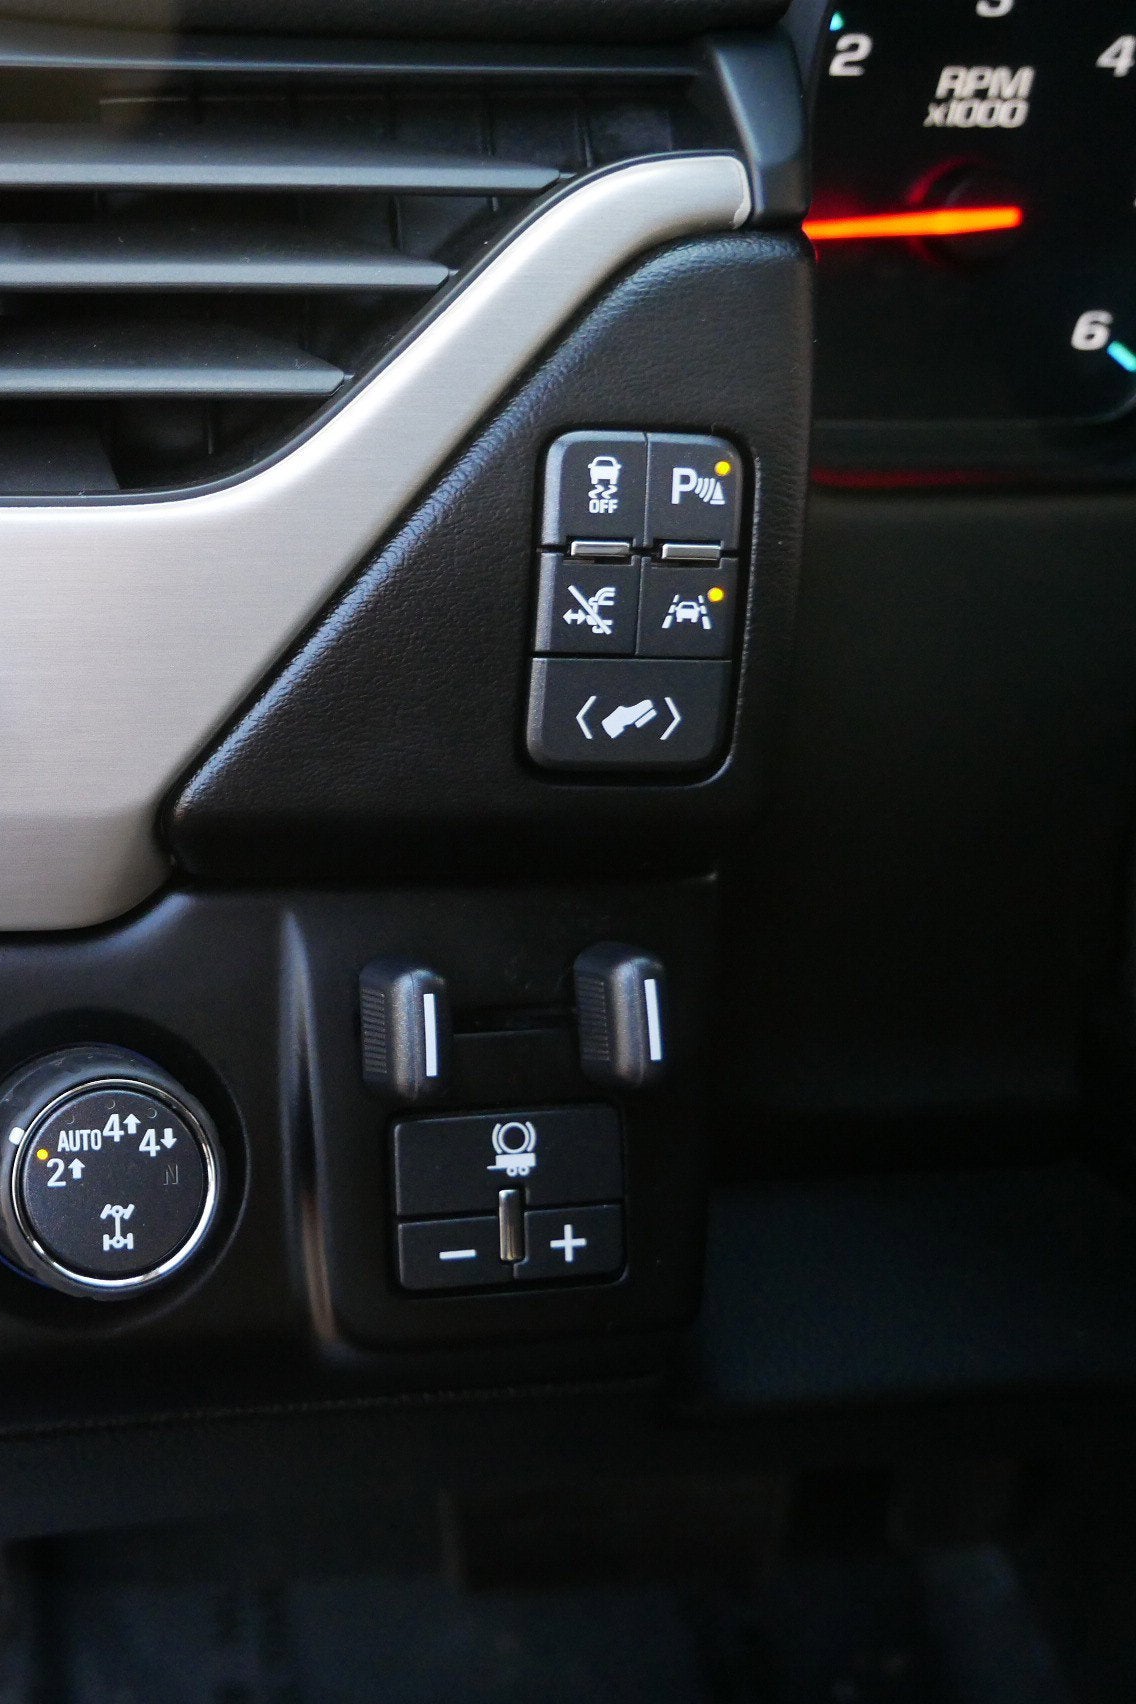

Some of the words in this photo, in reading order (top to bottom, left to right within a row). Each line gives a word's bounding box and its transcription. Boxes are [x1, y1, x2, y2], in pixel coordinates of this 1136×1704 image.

[829, 33, 873, 77] 2
[1095, 35, 1136, 77] 4
[935, 65, 1035, 100] RPM
[923, 99, 1029, 128] x1000
[1071, 309, 1113, 351] 6
[588, 500, 618, 514] OFF
[57, 1129, 102, 1152] AUTO
